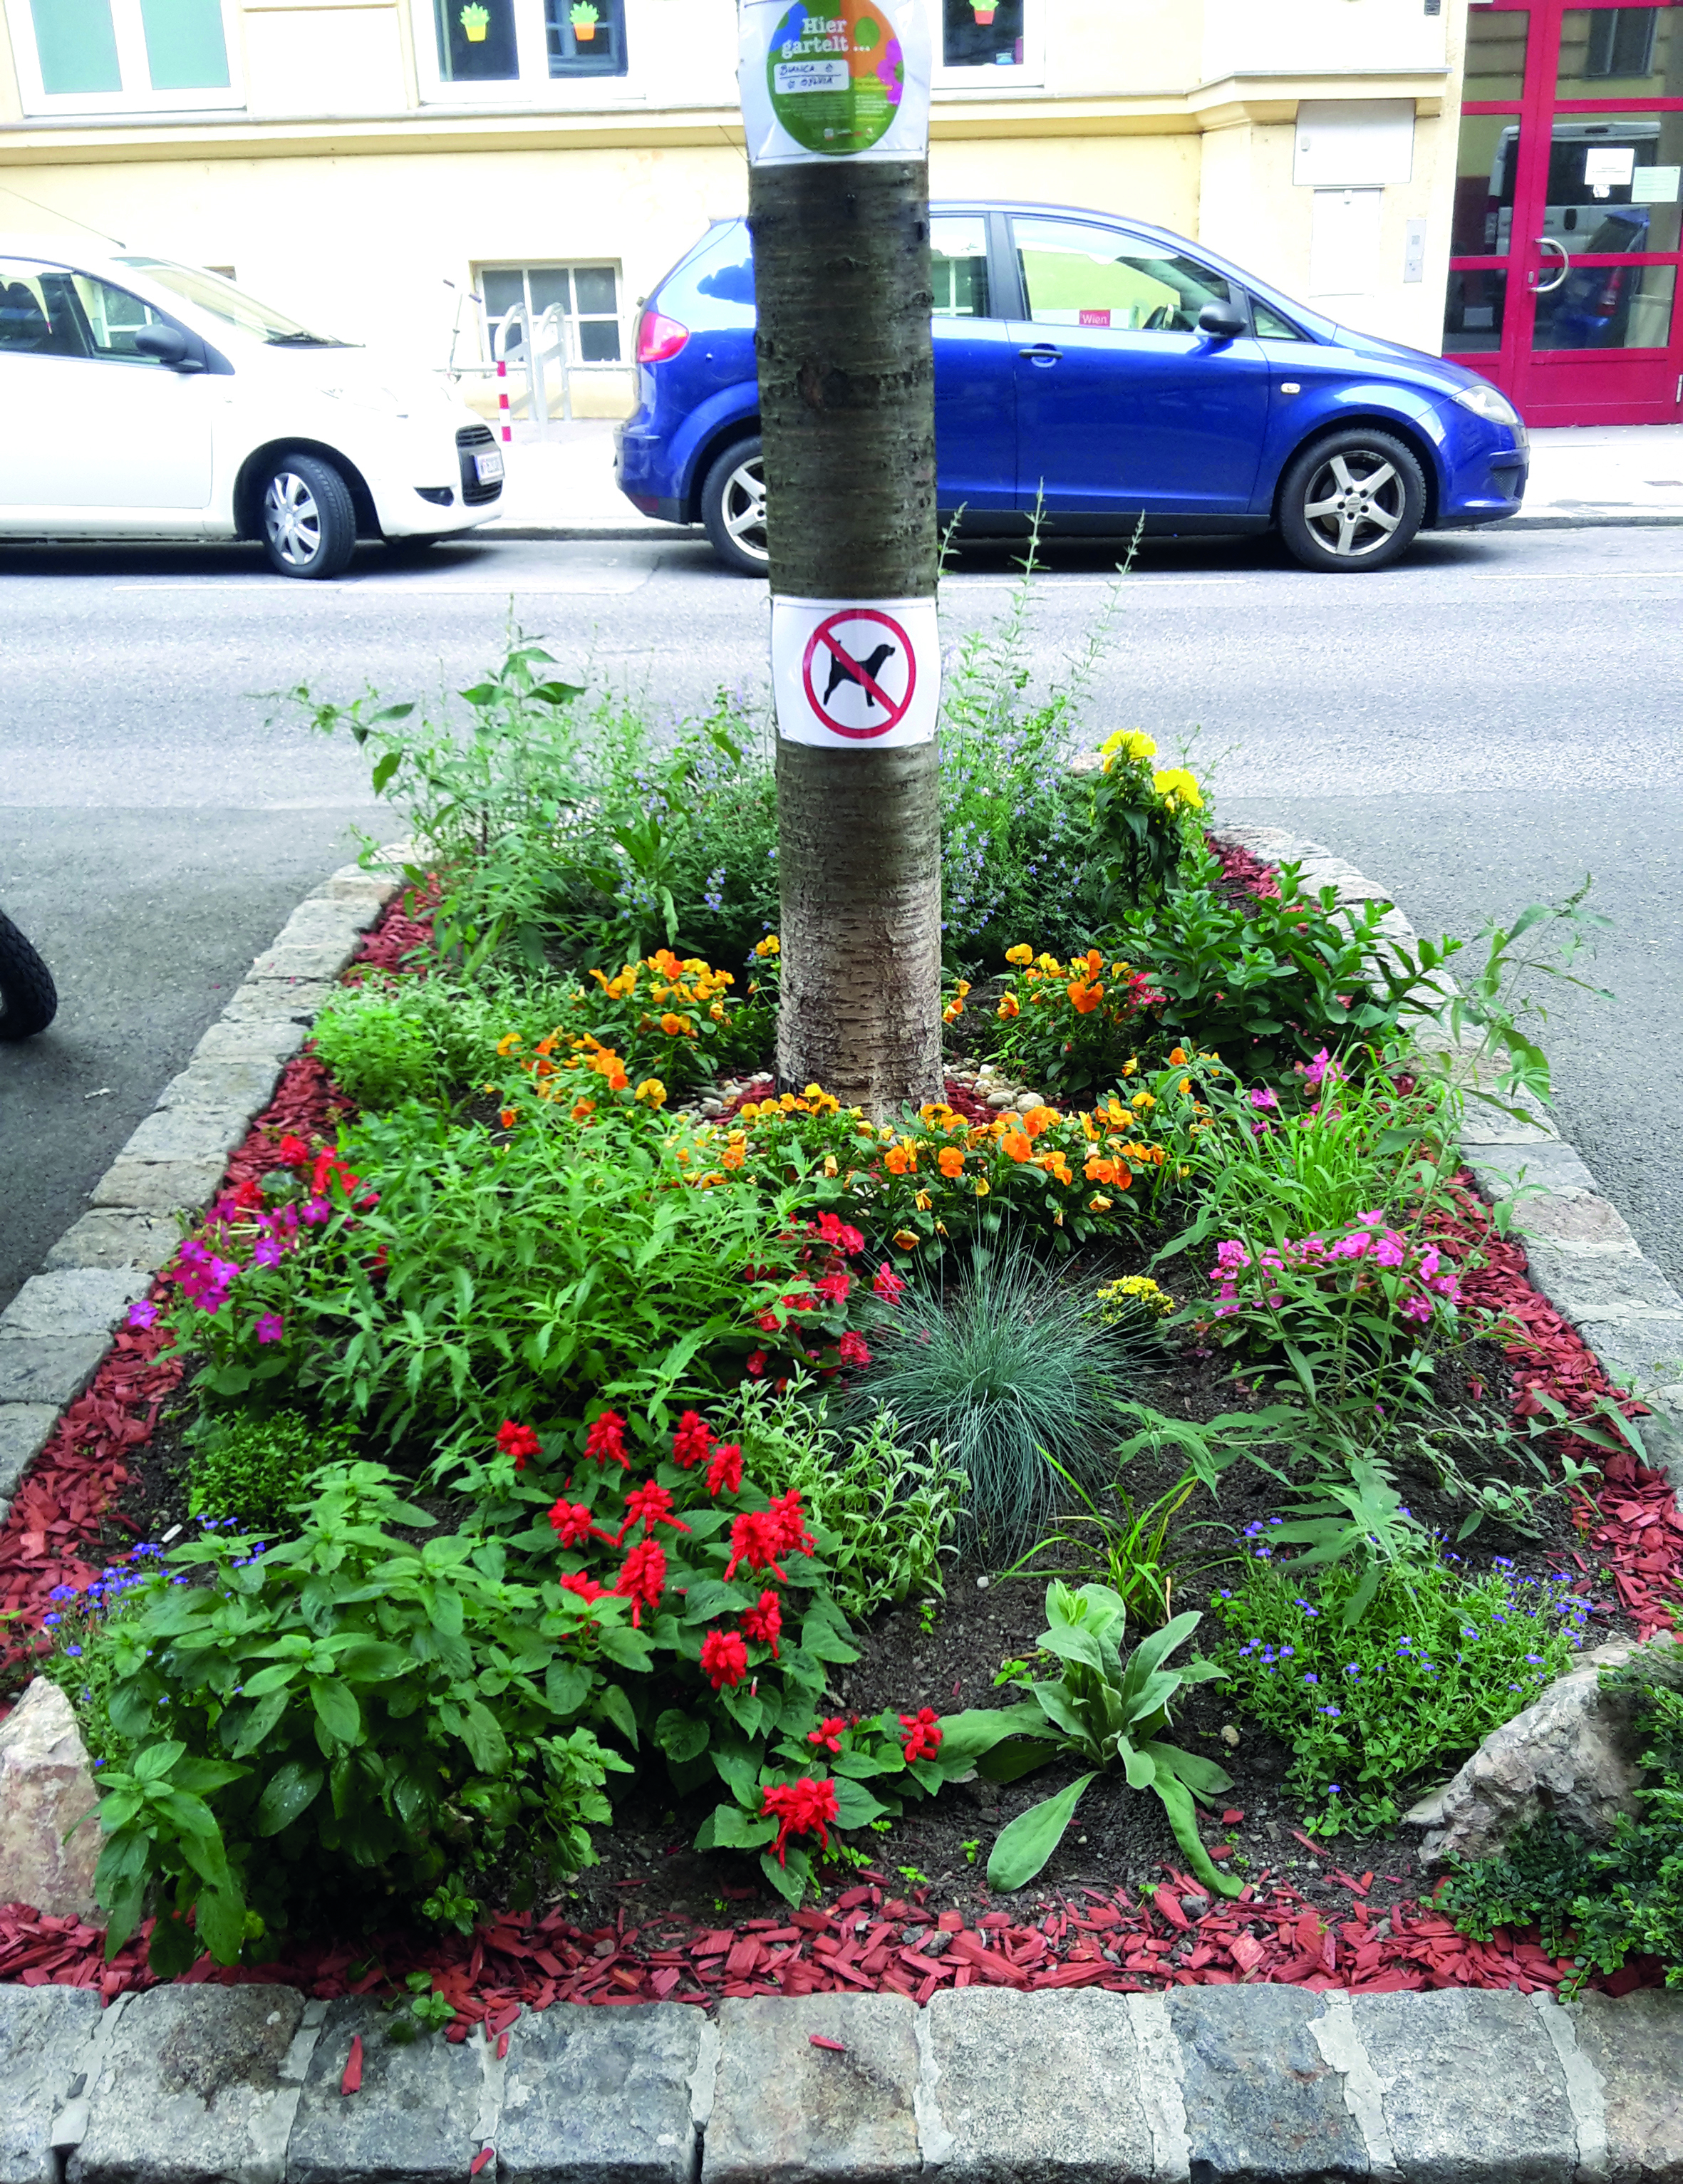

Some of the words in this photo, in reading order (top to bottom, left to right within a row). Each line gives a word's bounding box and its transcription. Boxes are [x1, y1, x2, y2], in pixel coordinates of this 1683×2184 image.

[802, 16, 846, 34] Hier
[782, 36, 849, 59] gartelt
[1082, 314, 1107, 324] Wien
